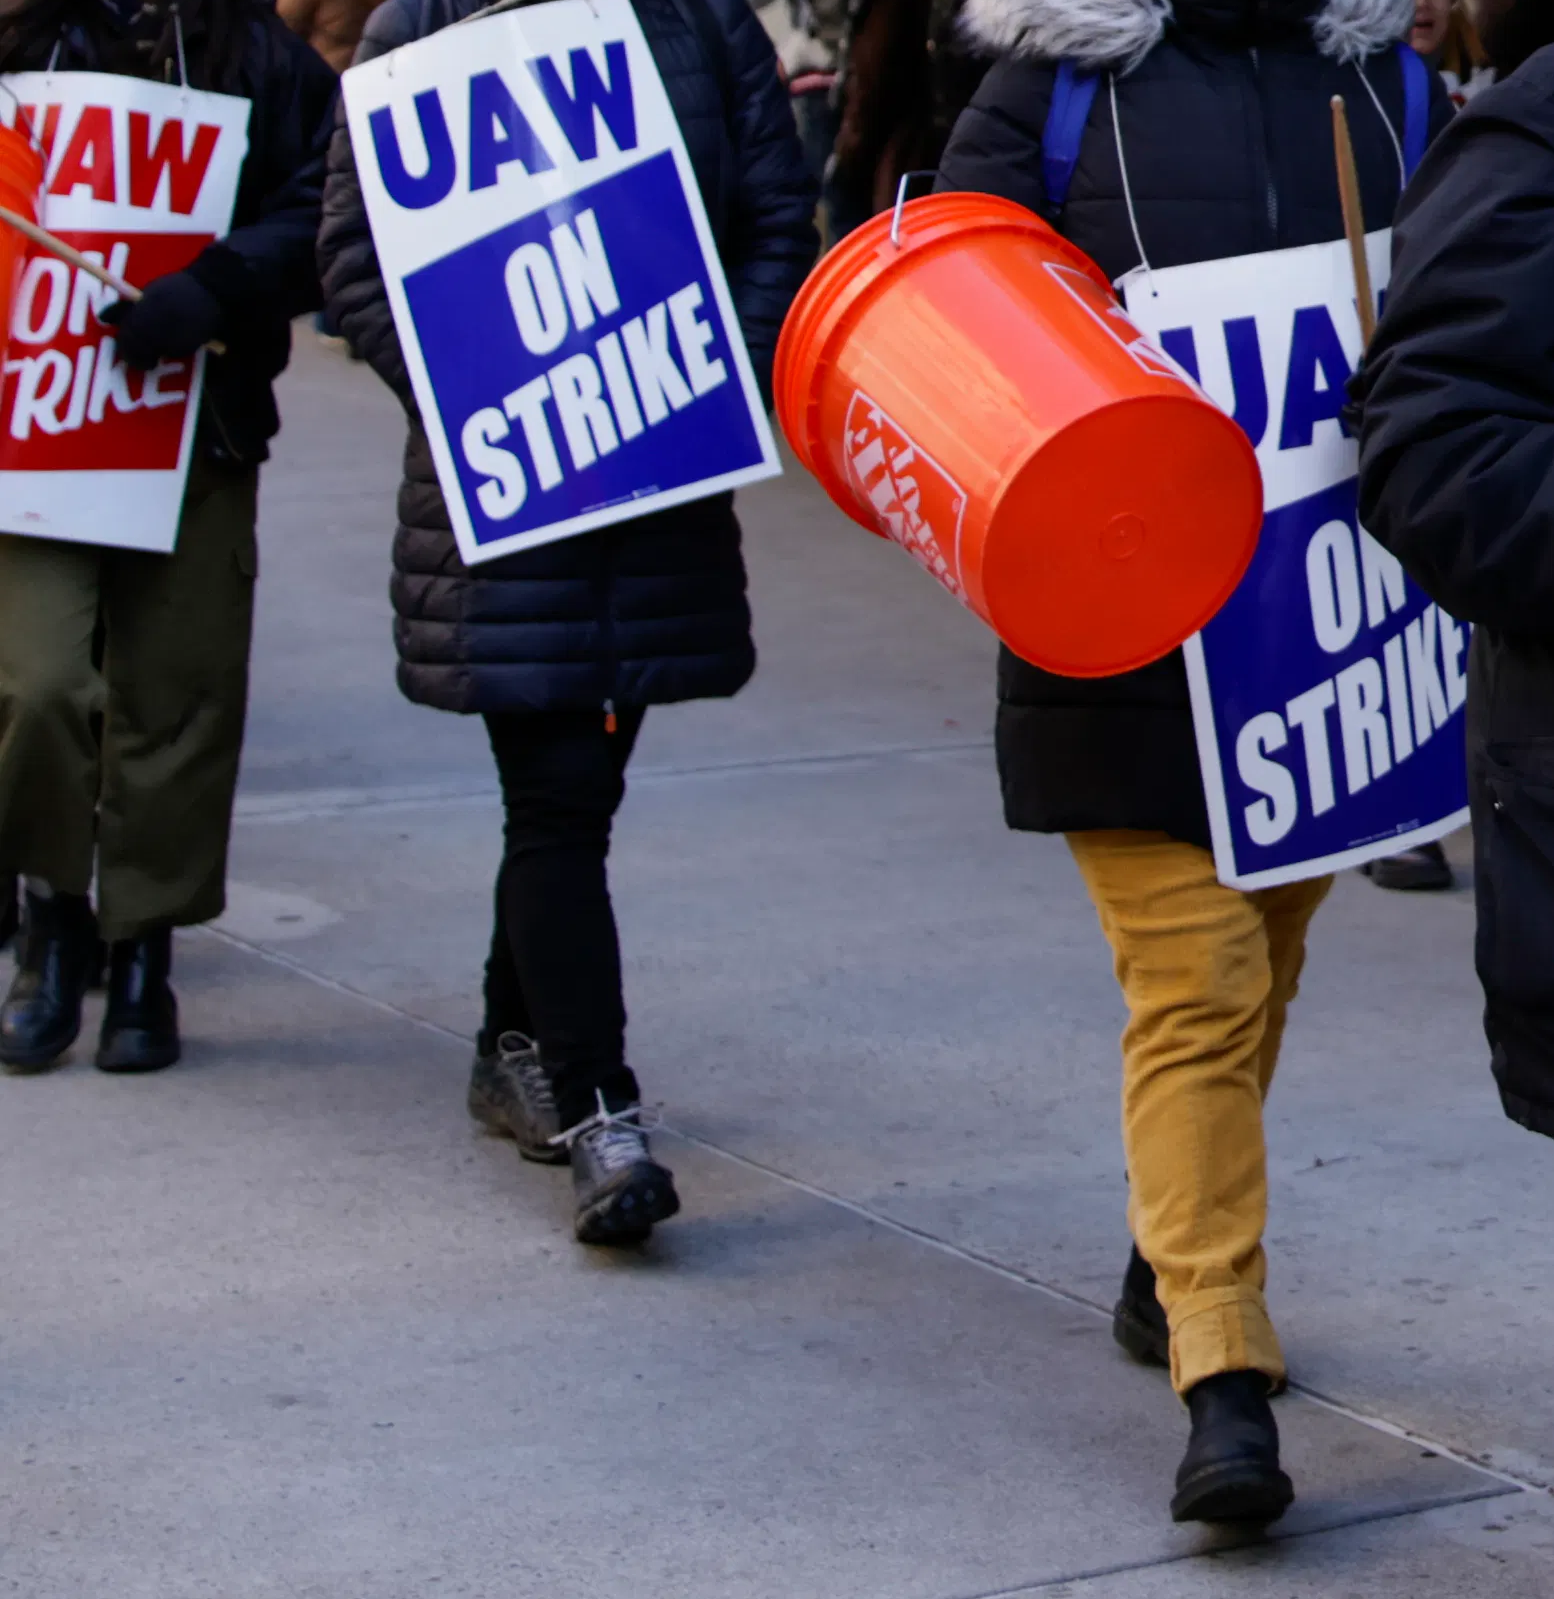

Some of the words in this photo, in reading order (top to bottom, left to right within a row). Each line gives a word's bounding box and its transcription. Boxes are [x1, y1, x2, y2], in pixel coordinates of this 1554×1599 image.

[368, 40, 638, 210] UAW
[504, 208, 622, 358] ON
[461, 281, 728, 522] STRIKE
[1235, 601, 1468, 847] STRIKE
